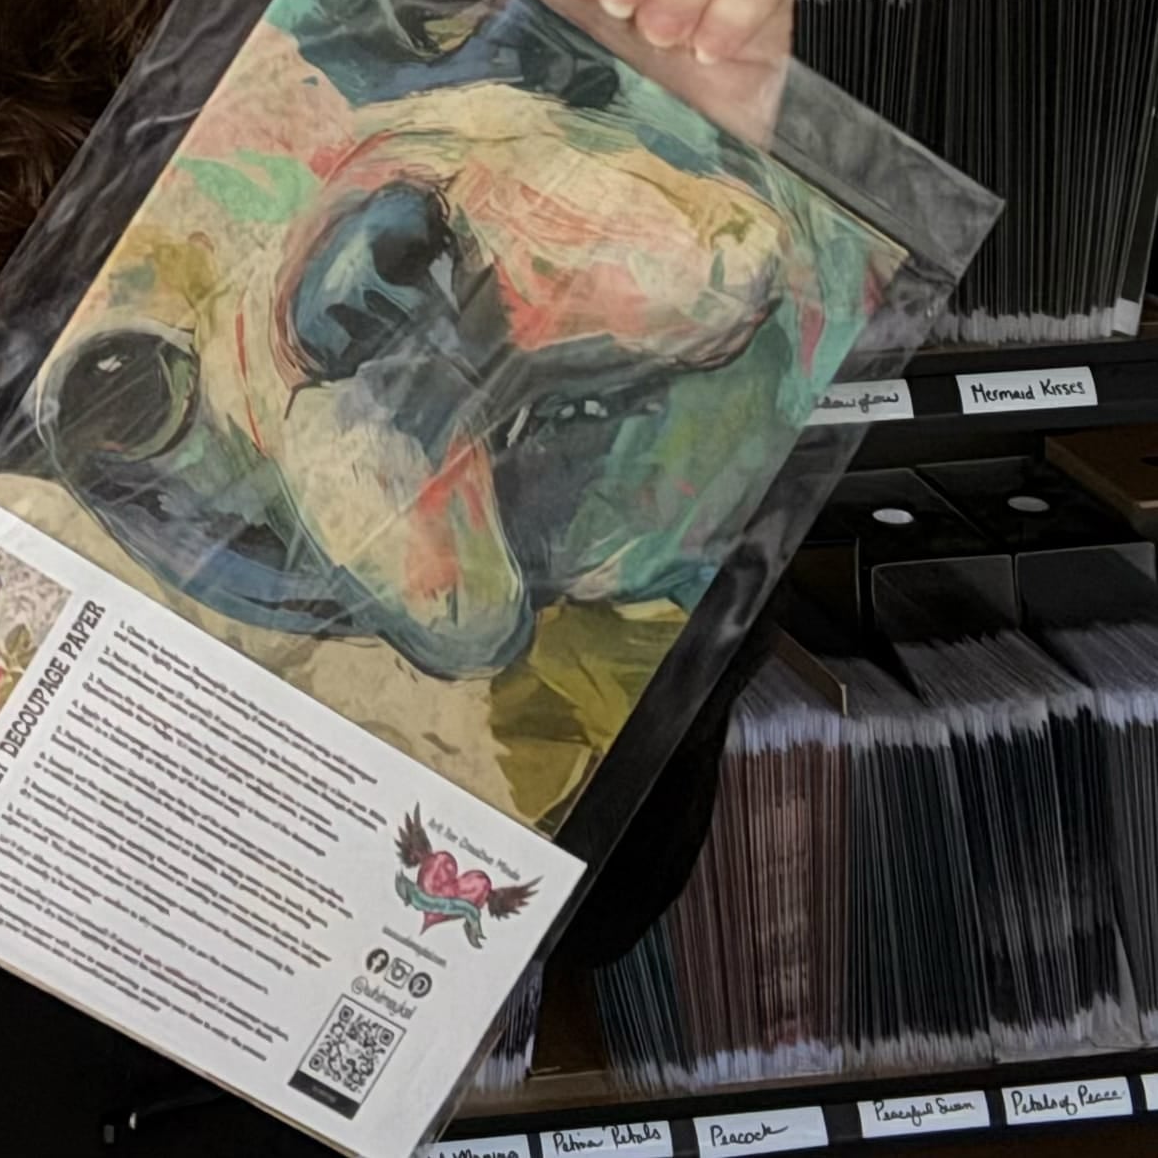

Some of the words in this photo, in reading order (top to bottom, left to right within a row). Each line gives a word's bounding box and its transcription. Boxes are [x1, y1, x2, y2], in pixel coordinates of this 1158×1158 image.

[970, 383, 1036, 403] Mermaid
[1038, 378, 1086, 395] Kisses
[57, 600, 106, 661] PAPER
[872, 1099, 933, 1127] Peaceful
[709, 1122, 789, 1148] Peacock
